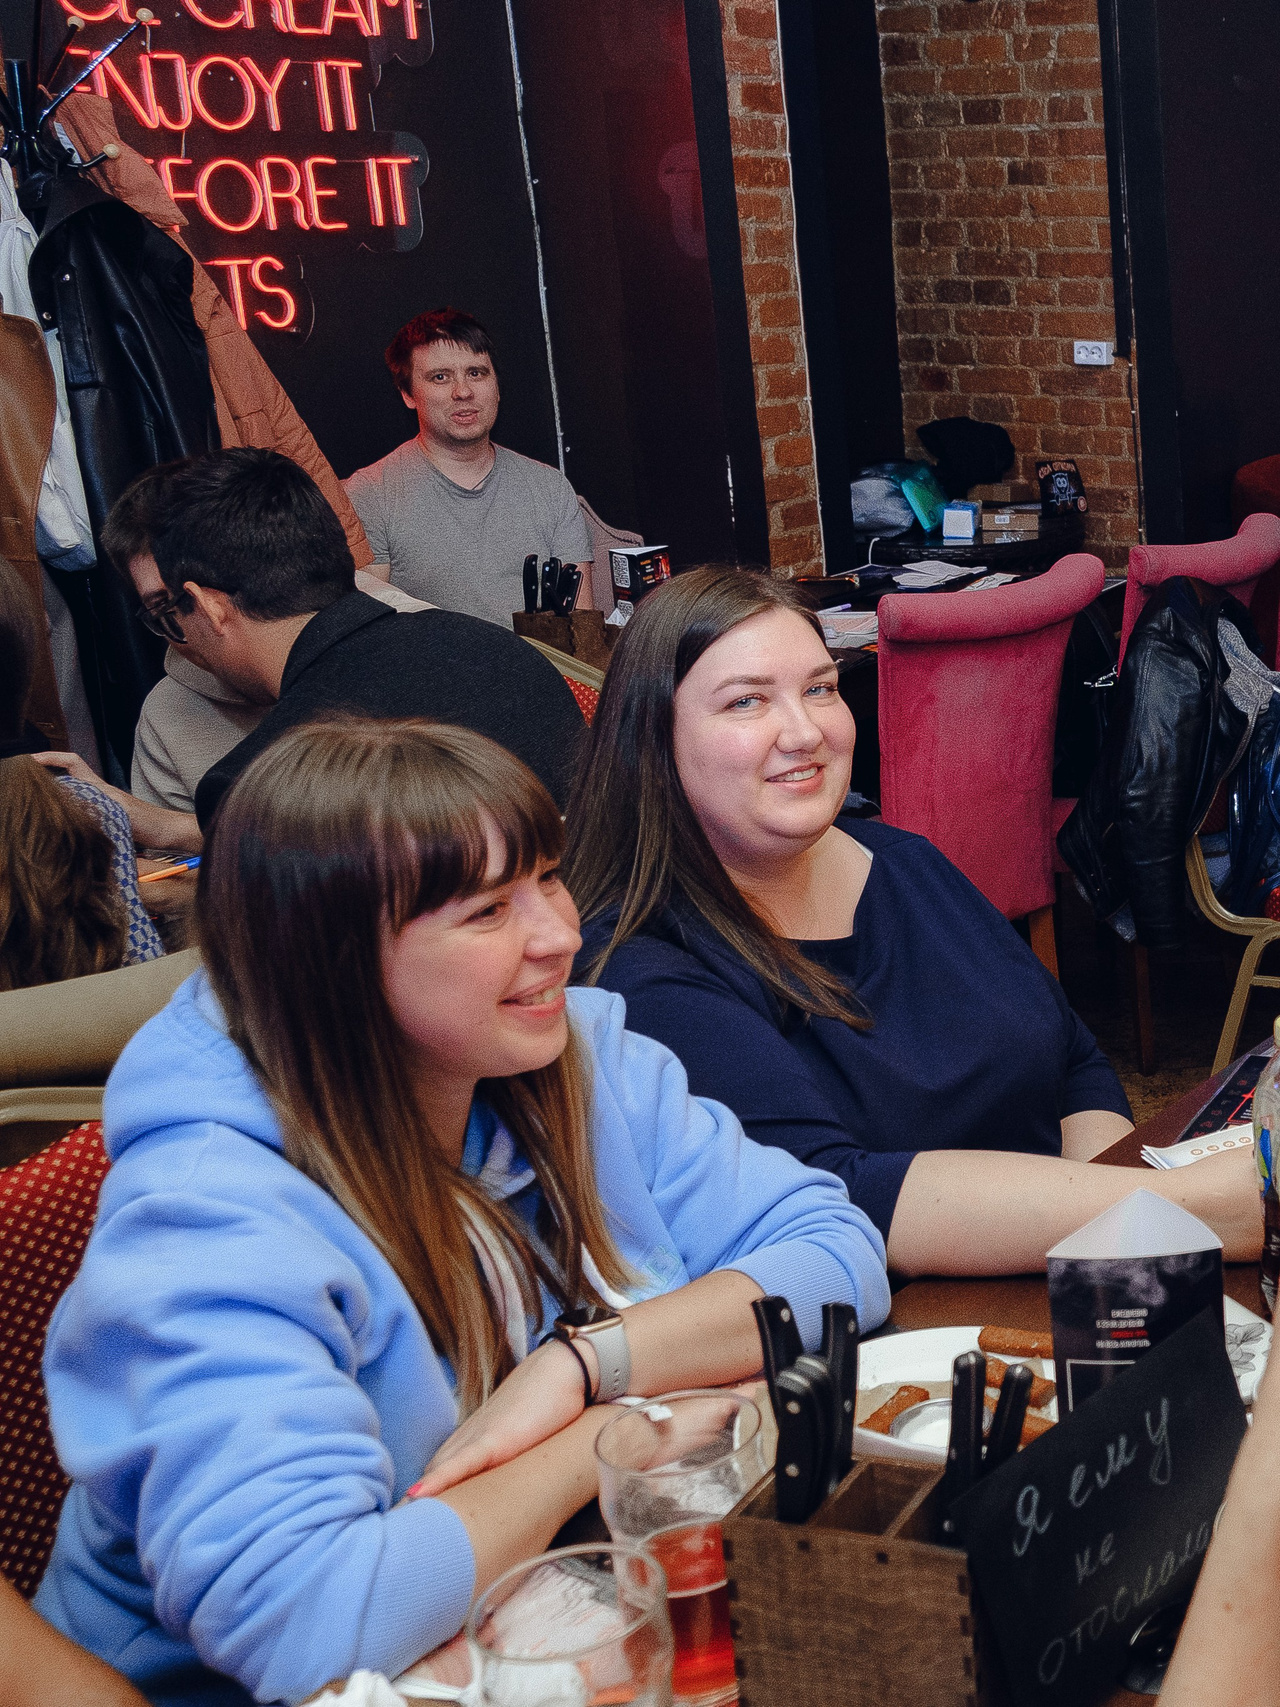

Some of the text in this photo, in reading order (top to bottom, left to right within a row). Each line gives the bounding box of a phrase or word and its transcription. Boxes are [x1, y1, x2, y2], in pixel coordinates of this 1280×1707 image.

[314, 61, 362, 131] IT
[145, 157, 412, 233] FORE IT
[1012, 1485, 1053, 1557] Я
